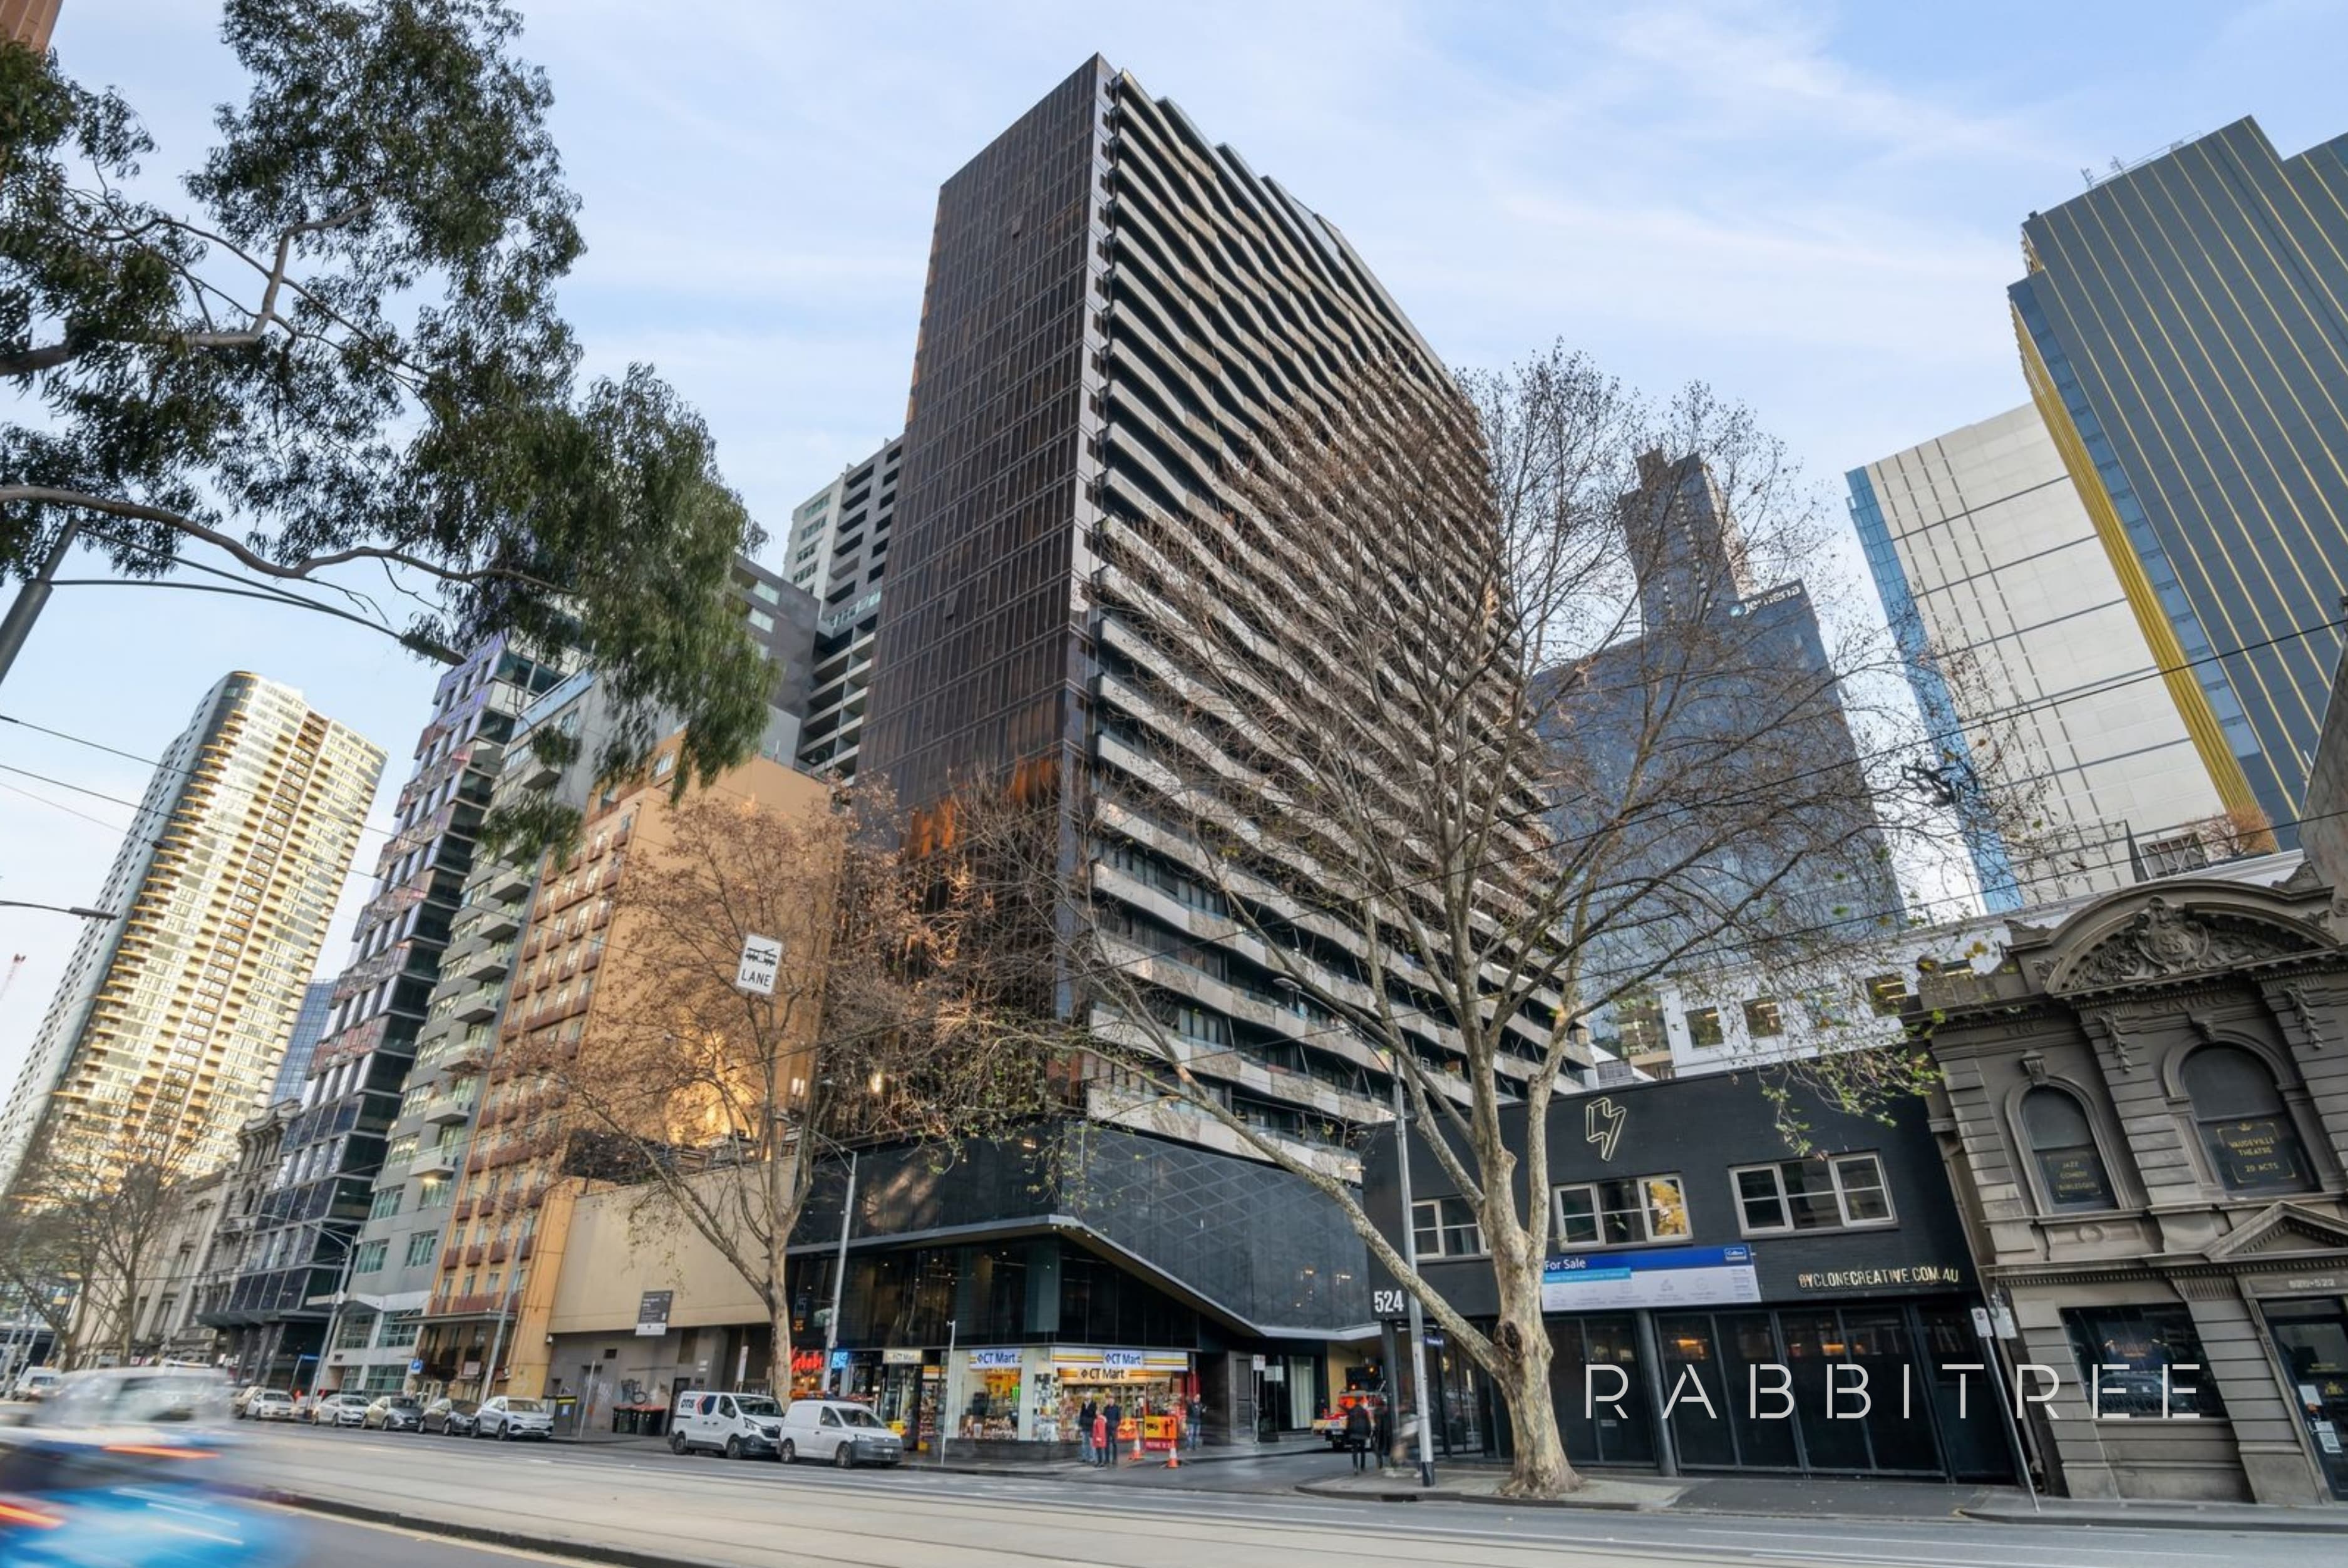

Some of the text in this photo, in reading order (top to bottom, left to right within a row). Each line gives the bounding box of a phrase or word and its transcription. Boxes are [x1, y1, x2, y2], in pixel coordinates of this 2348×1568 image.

[741, 968, 772, 987] LANE
[1545, 1258, 1587, 1271] For Sale
[1374, 1289, 1404, 1313] 524
[984, 1352, 1016, 1364] CT Mart
[1111, 1353, 1141, 1366] CT Mart
[1089, 1368, 1125, 1379] CT Mart
